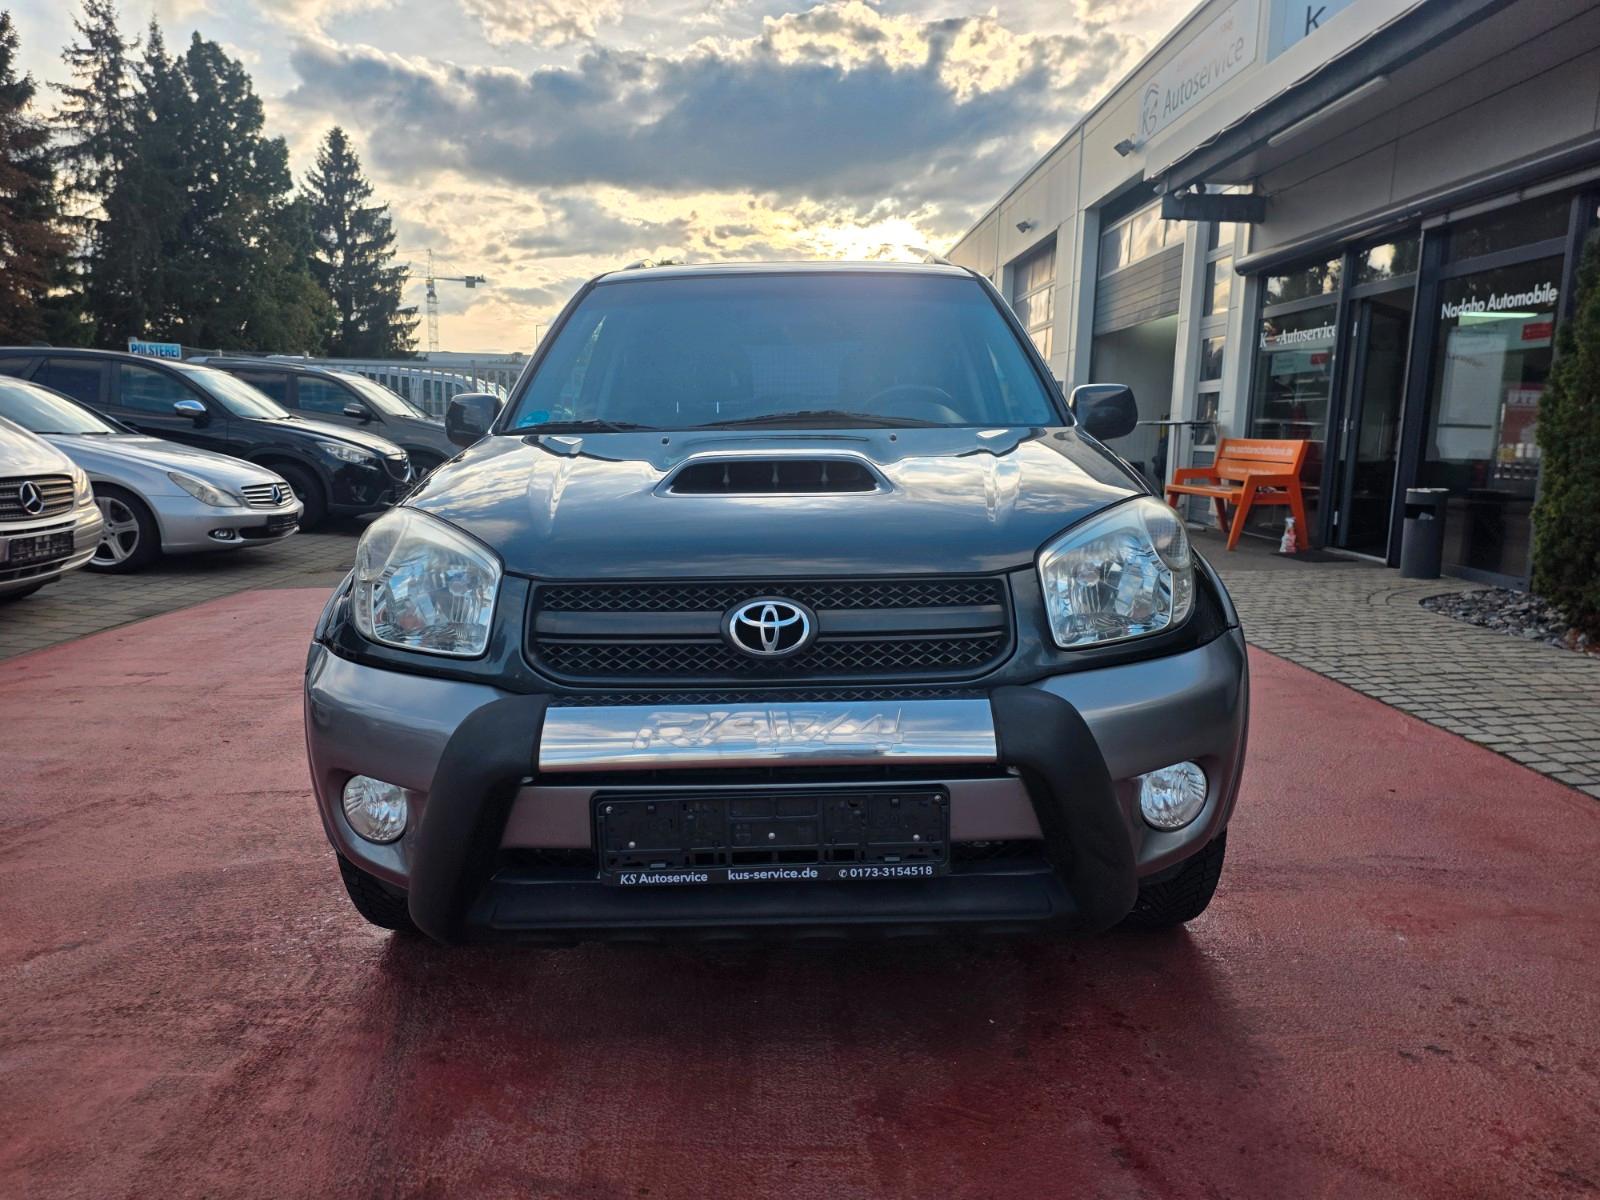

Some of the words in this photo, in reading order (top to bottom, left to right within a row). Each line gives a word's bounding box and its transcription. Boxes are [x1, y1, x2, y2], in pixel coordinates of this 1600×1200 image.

[1162, 36, 1244, 119] Autoservice
[1487, 281, 1558, 311] Automobile
[131, 343, 179, 358] POLSTEREI
[620, 873, 637, 885] KS
[639, 871, 708, 884] Autoservice
[728, 867, 818, 880] kus-service.de
[850, 865, 932, 878] 0173-3154518
